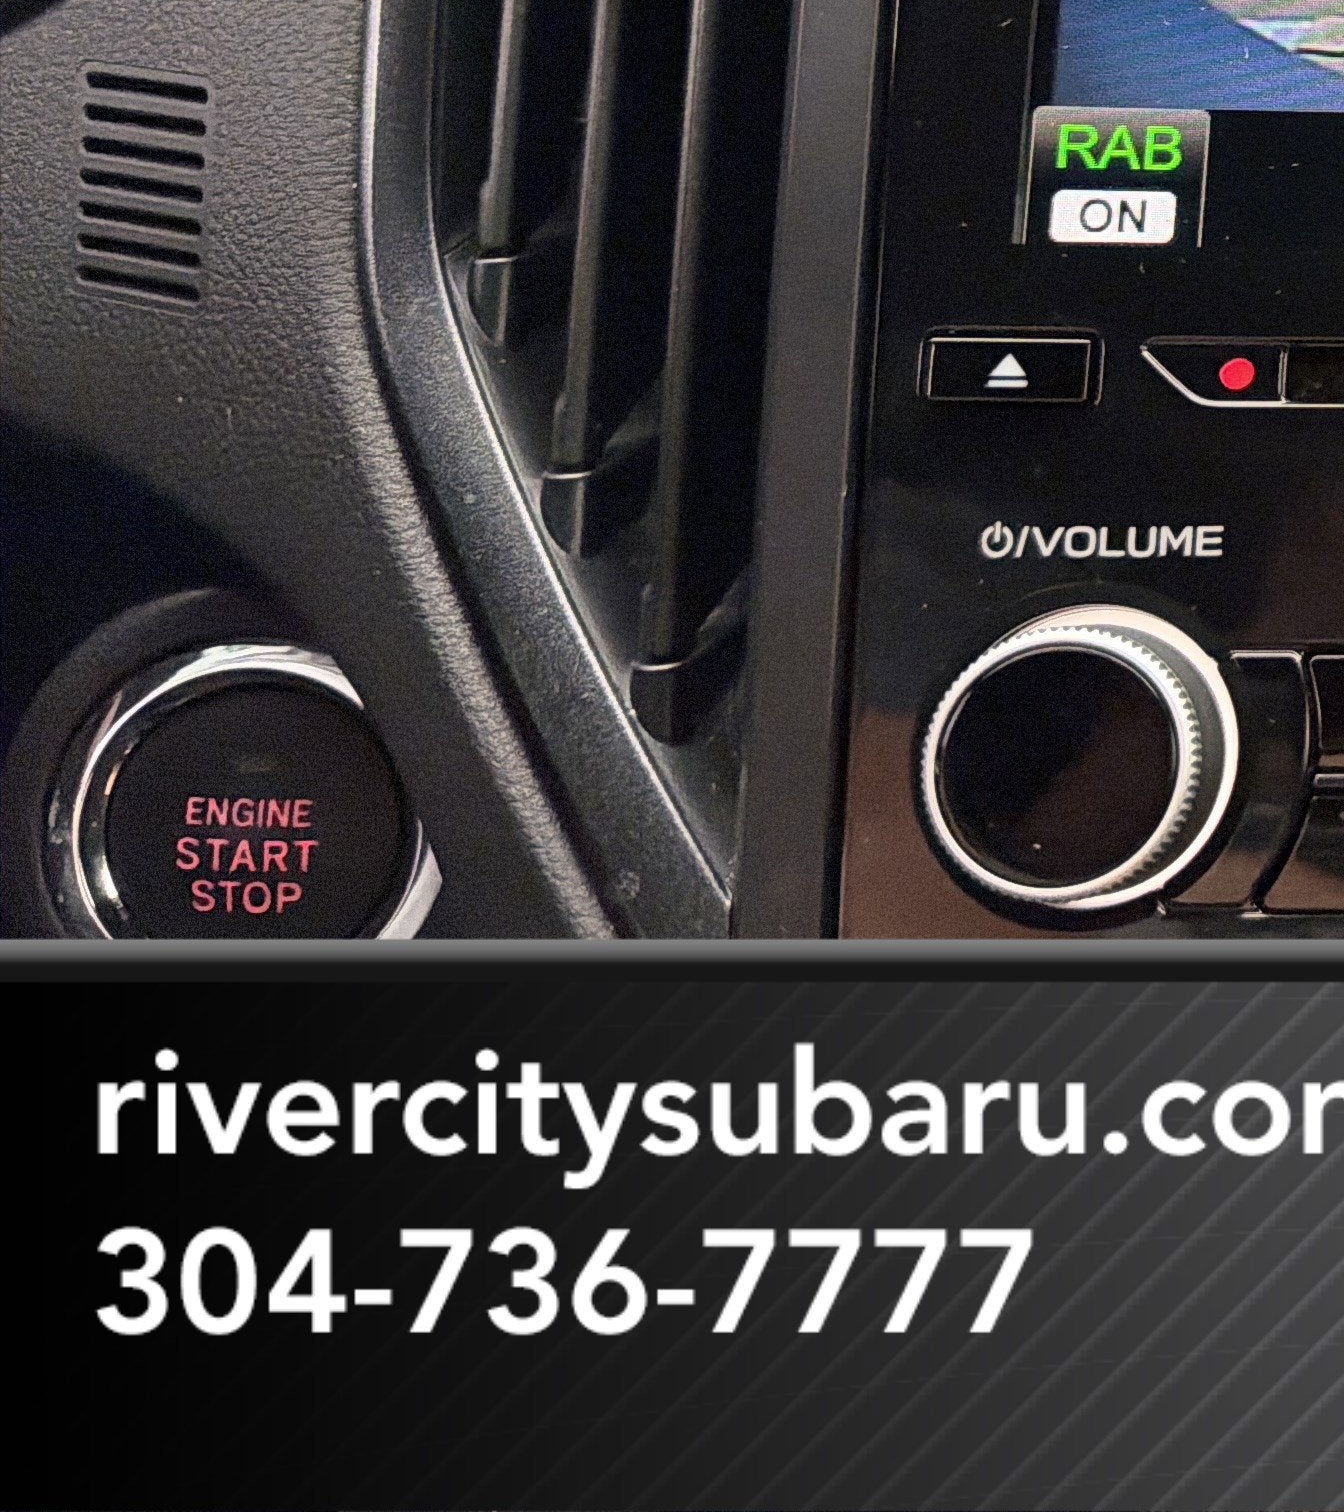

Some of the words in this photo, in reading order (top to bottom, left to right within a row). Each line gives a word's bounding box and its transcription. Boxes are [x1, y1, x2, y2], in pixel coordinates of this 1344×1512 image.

[1055, 123, 1183, 172] RAB
[1080, 199, 1147, 233] ON
[184, 796, 313, 829] ENGINE
[175, 835, 319, 873] START
[190, 879, 302, 915] STOP
